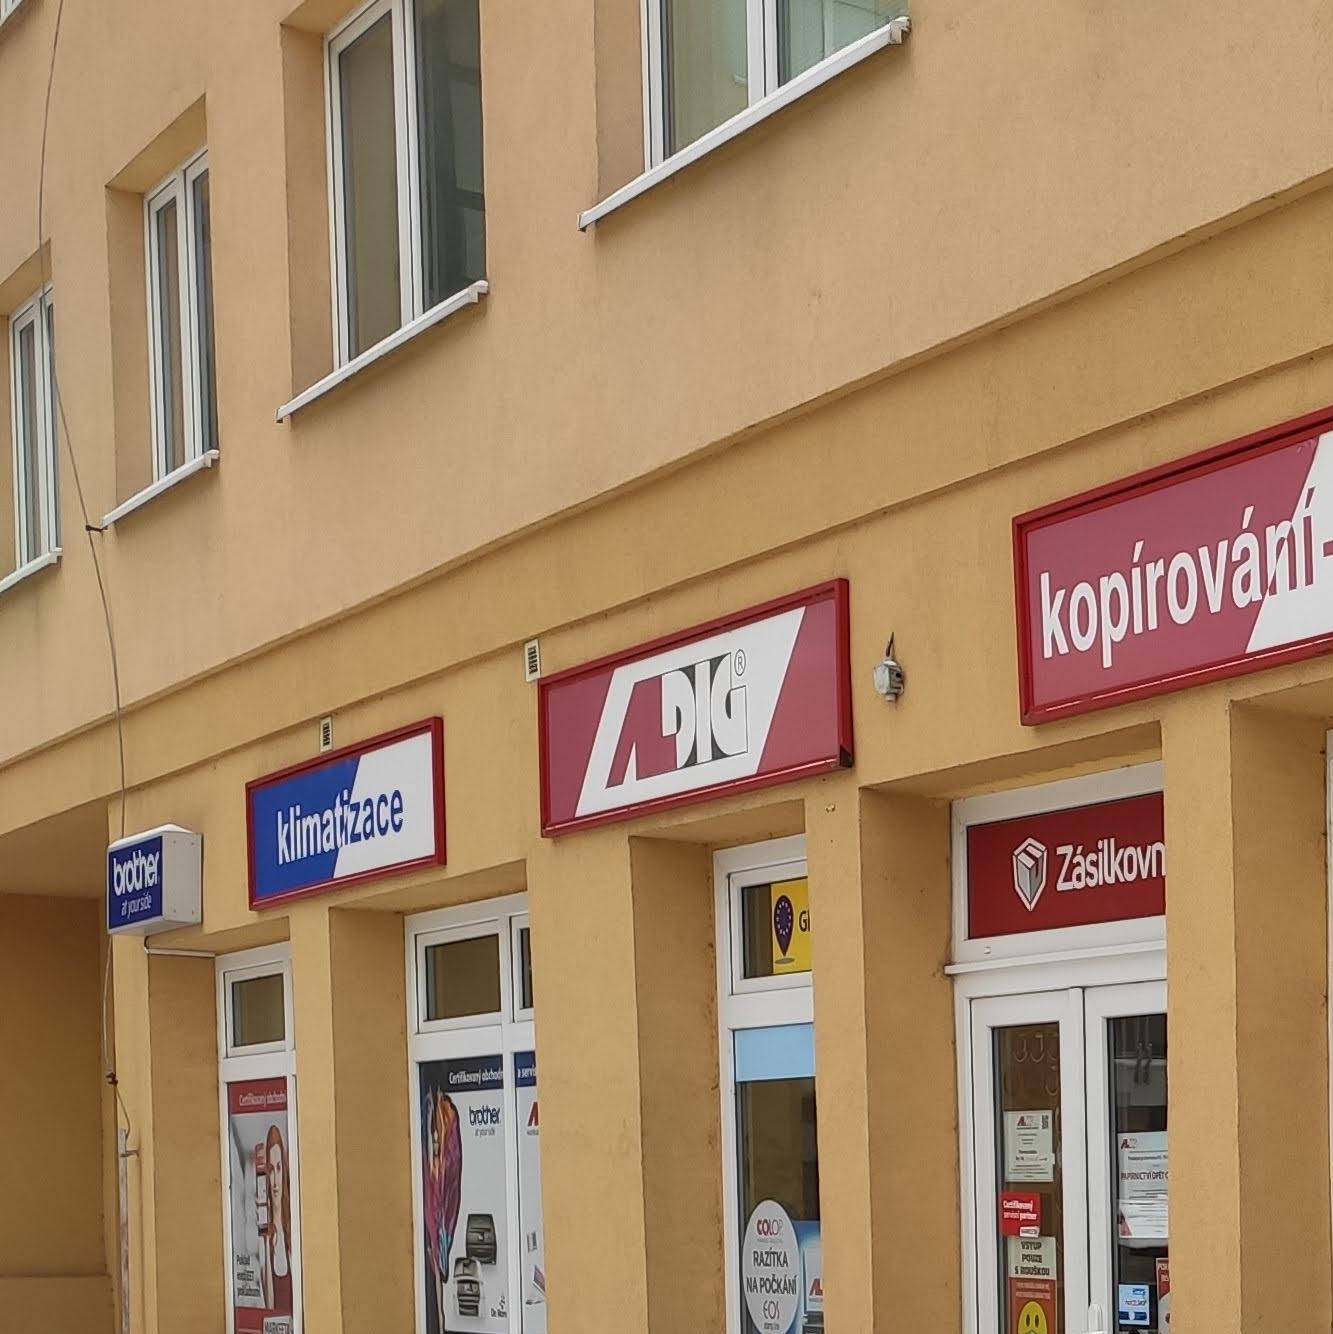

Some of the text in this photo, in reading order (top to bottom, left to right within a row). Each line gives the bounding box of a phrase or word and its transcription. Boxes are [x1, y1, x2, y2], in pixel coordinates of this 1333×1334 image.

[277, 789, 403, 865] klimatizace
[113, 849, 160, 896] brother
[469, 1104, 500, 1126] brother
[753, 1246, 788, 1268] RAZÍTKA
[746, 1274, 797, 1296] NA POČKÁNÍ
